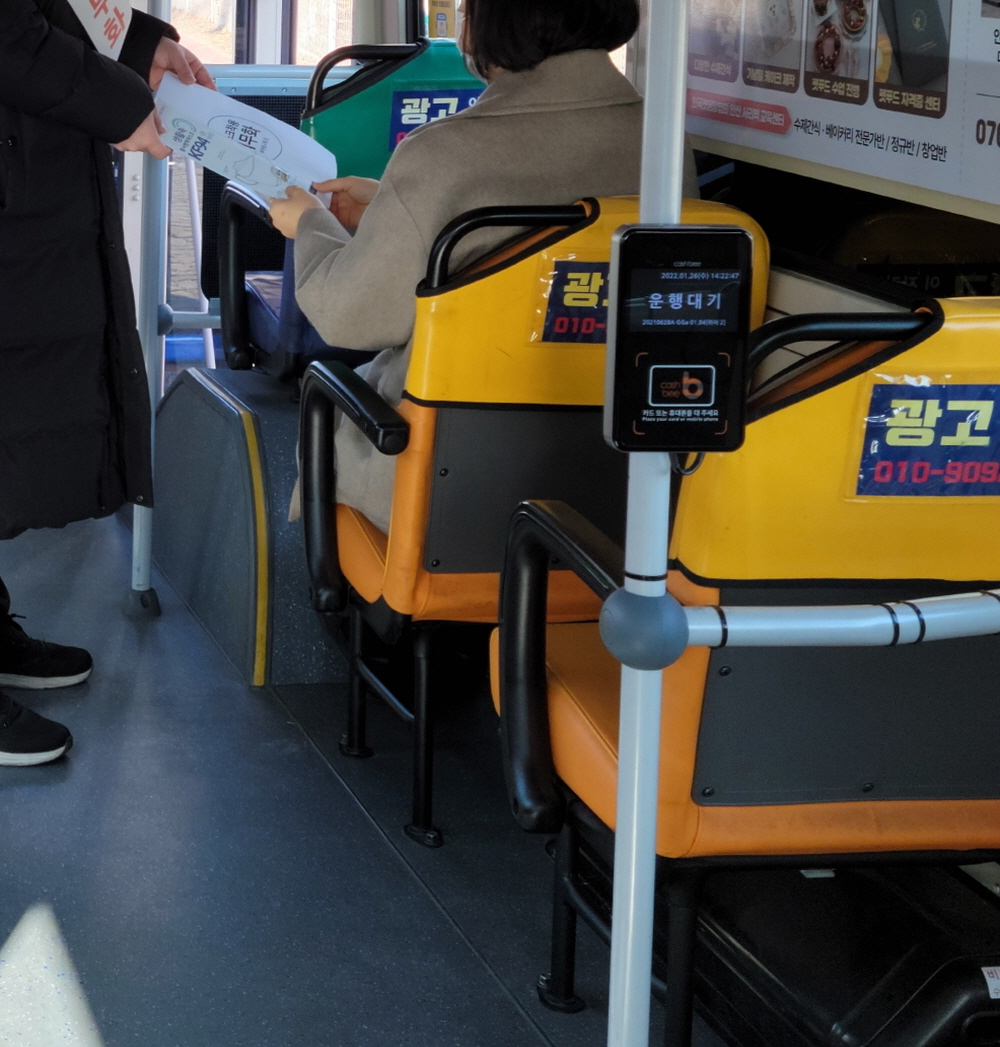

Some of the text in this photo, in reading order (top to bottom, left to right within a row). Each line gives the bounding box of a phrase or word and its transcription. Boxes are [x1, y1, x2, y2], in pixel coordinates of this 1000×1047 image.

[811, 78, 831, 94] 펫푸드
[831, 81, 846, 97] 수업
[879, 88, 941, 112] 펫푸드 자격증 센터
[401, 97, 459, 125] 광고
[188, 136, 211, 161] KF94
[793, 117, 822, 137] 수제간식
[825, 123, 854, 143] 베이커리
[855, 129, 885, 150] 전문가반
[891, 136, 915, 156] 정규반
[921, 141, 948, 162] 창업반
[563, 271, 608, 307] 광
[885, 398, 994, 447] 광고
